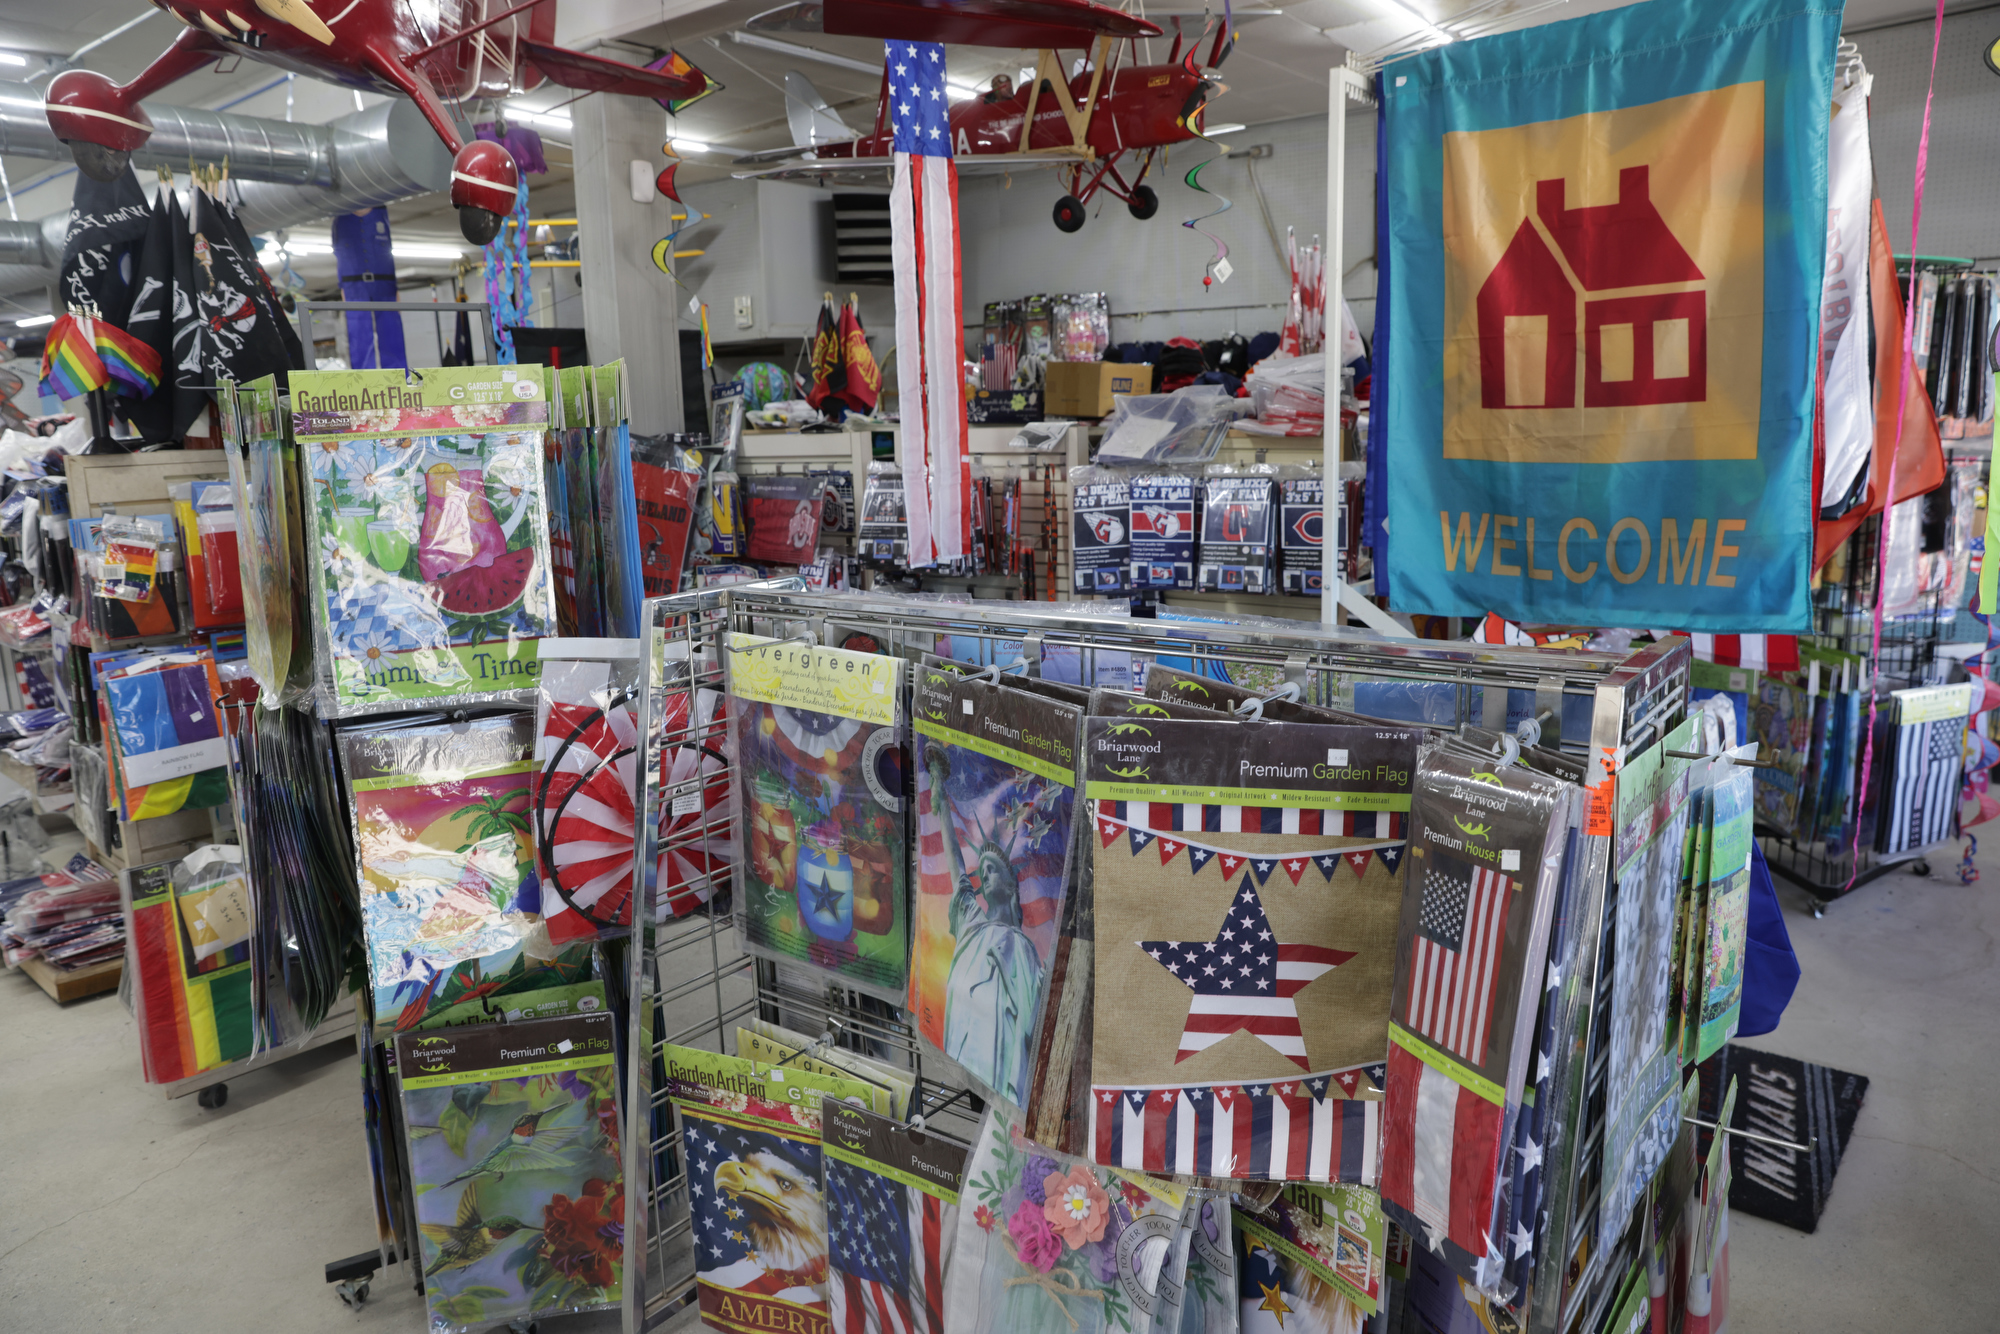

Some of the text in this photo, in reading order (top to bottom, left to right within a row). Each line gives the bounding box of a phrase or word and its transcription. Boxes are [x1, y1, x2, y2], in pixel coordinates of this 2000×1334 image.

[449, 386, 465, 400] G
[467, 381, 504, 391] GARDEN SIZE
[1112, 378, 1133, 393] ULINE
[297, 386, 424, 413] GardenArtFlag
[1090, 484, 1129, 494] DELUXE
[1222, 478, 1268, 488] DELUXE
[635, 498, 687, 524] EVELAND
[1439, 510, 1746, 588] WELCOME
[746, 647, 871, 676] evergreen
[778, 682, 837, 701] Decorative Garden Flag
[921, 685, 953, 703] Briarwood
[930, 698, 943, 709] Lane
[872, 731, 891, 745] TOCAR
[984, 716, 1020, 741] Premium
[1021, 728, 1052, 752] Garden
[1053, 739, 1072, 763] Flag
[1097, 739, 1162, 754] Briarwood
[864, 746, 874, 783] TOUCHER
[1117, 752, 1141, 763] Lane
[1239, 760, 1409, 787] Premium Garden Flag
[873, 787, 895, 809] TOUCH
[1109, 786, 1134, 795] Premium
[1136, 787, 1156, 796] Quality
[1219, 790, 1243, 800] Original
[1244, 792, 1267, 800] Artwork
[1451, 784, 1508, 812] Briarwood
[1465, 802, 1486, 819] Lane
[1423, 826, 1463, 851] Premium
[1465, 840, 1495, 862] House
[536, 999, 569, 1011] GARDEN SIZE
[412, 1045, 456, 1058] Briarwood
[500, 1047, 546, 1060] Premium
[587, 1038, 609, 1050] Flag
[426, 1055, 443, 1063] Lane
[669, 1059, 766, 1103] GardenArtFlag
[787, 1087, 801, 1100] G
[833, 1115, 871, 1138] Briarwood
[844, 1129, 860, 1141] Lane
[1743, 1062, 1798, 1201] INDIANS
[911, 1155, 954, 1182] Premium
[1144, 1220, 1172, 1232] TOCAR
[1348, 1220, 1362, 1233] USA
[1121, 1228, 1142, 1270] TOUCHER
[1198, 1243, 1228, 1271] TOUCH
[1124, 1277, 1149, 1309] TOUCH
[718, 1295, 831, 1334] AMERI
